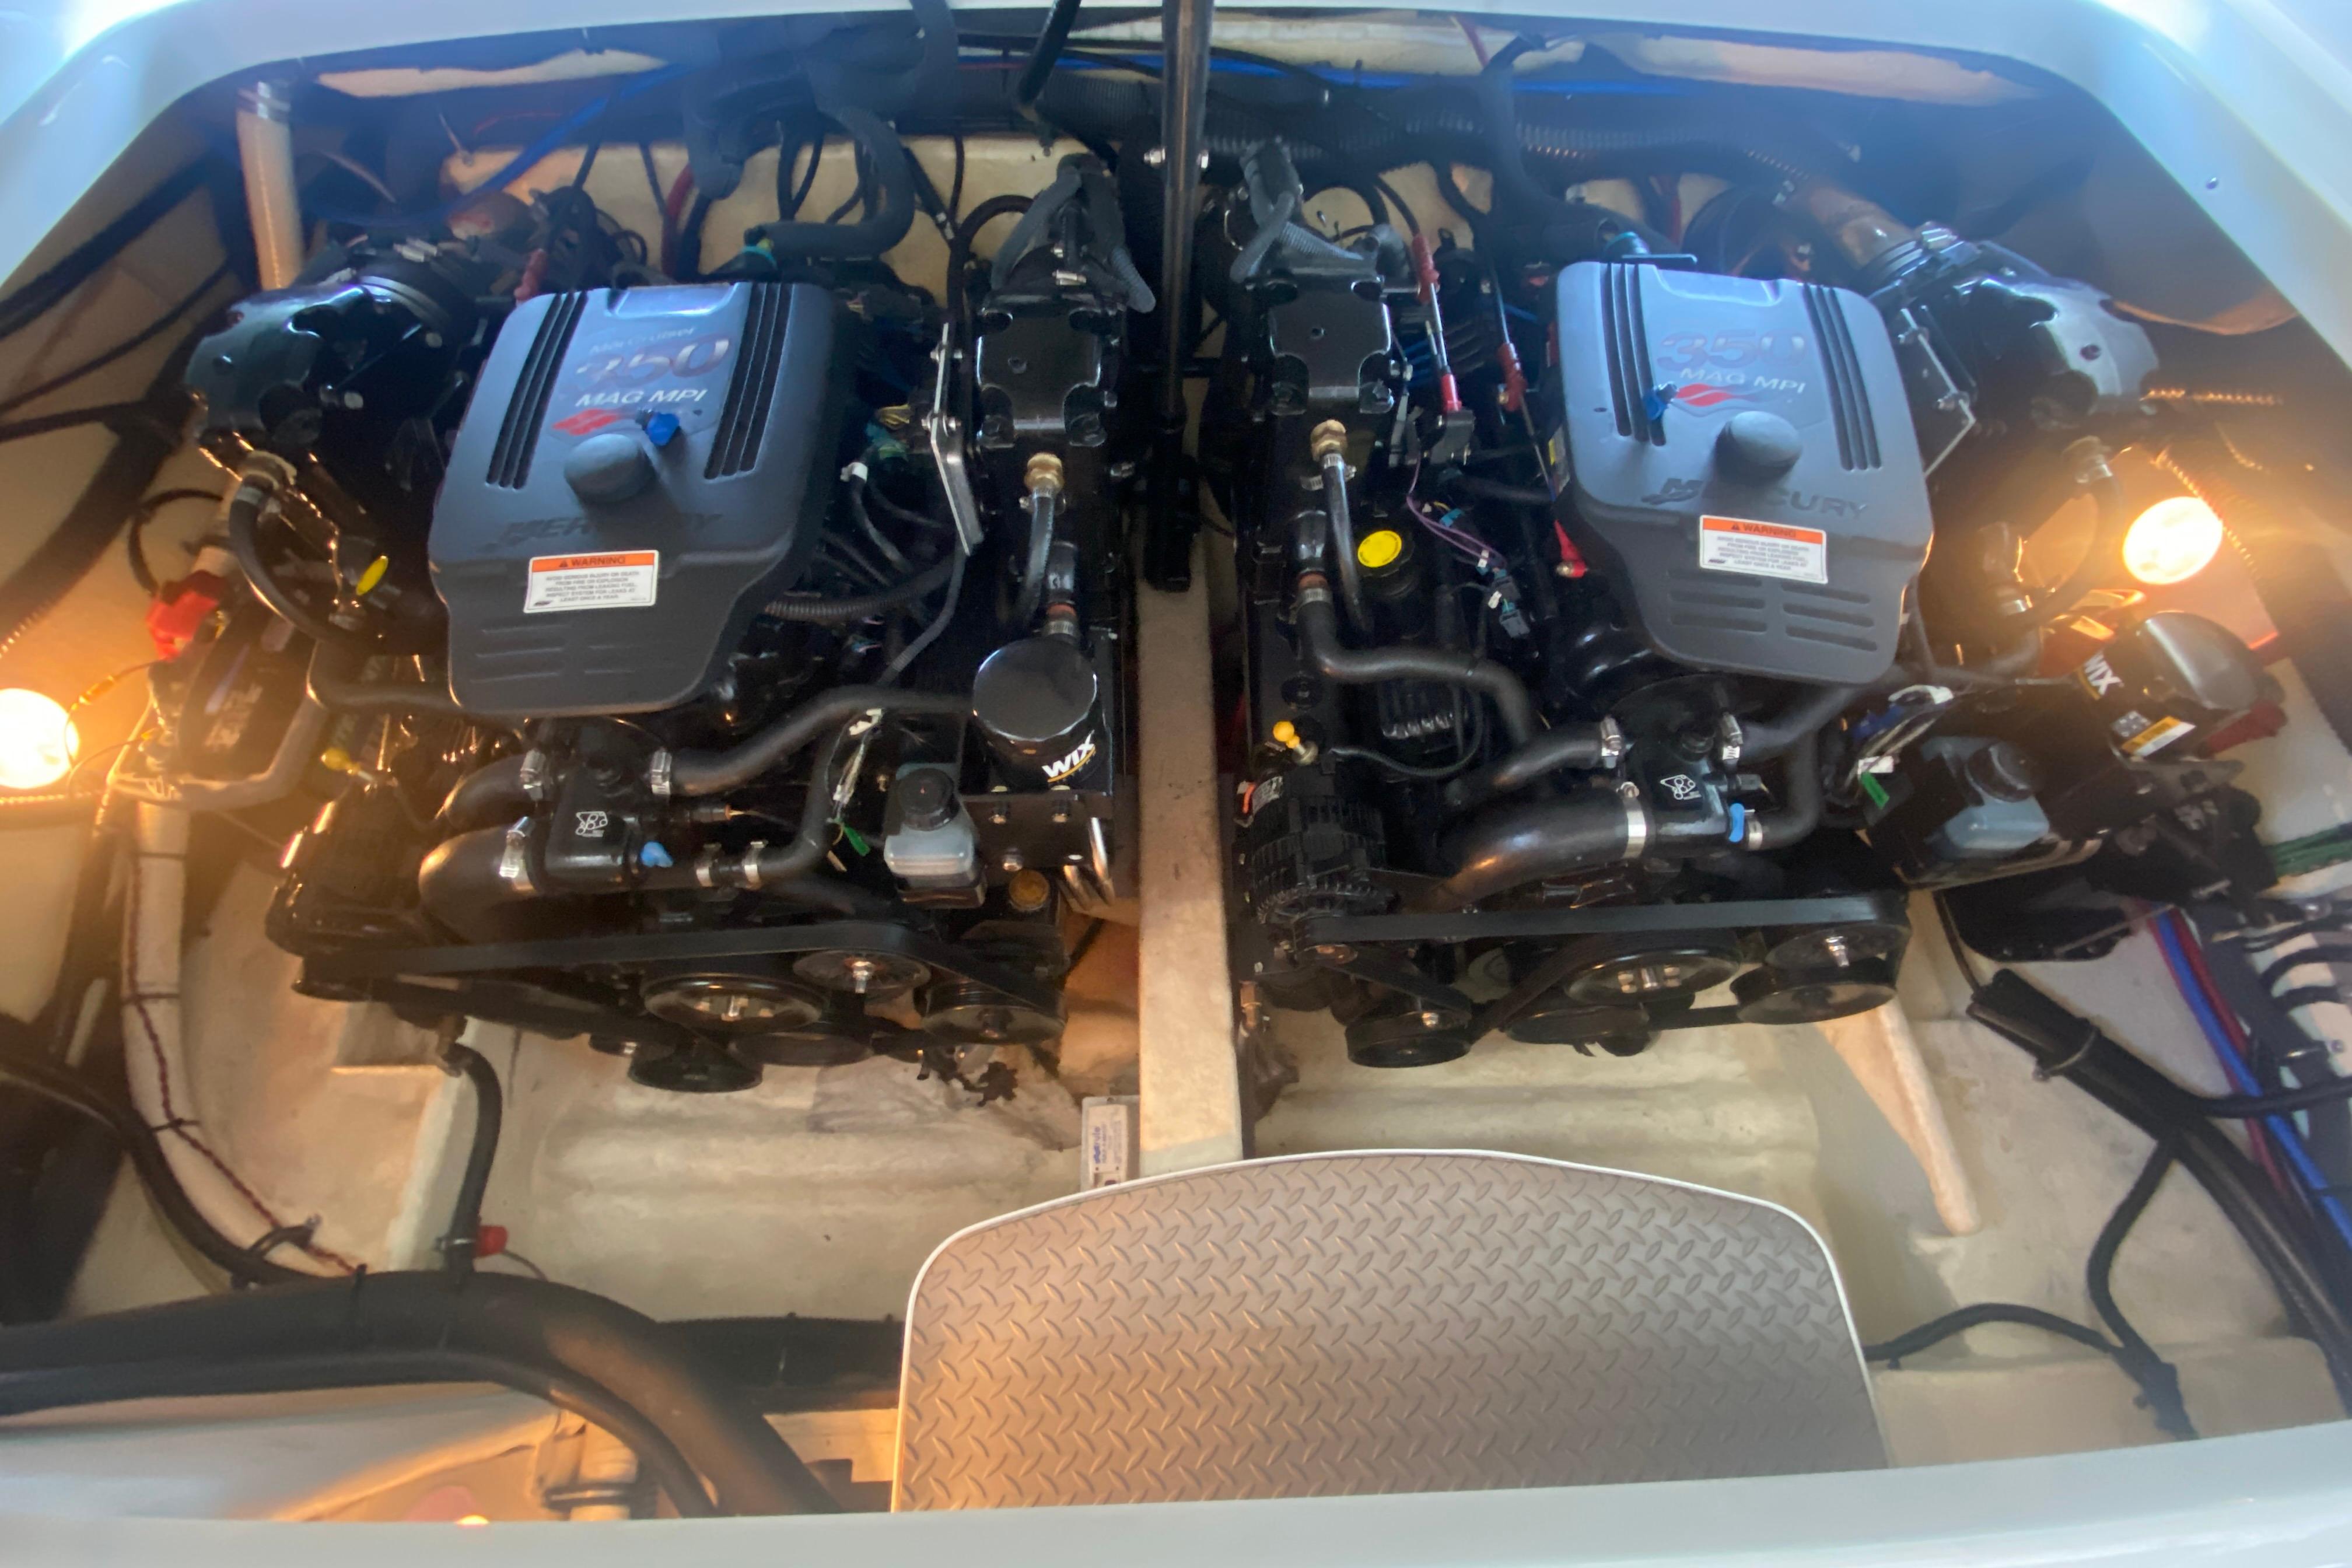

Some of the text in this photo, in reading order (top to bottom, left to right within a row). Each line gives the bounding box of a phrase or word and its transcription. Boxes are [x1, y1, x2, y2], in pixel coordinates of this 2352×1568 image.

[1657, 328, 1807, 372] 350
[1679, 367, 1807, 394] MAG MPI
[575, 388, 709, 407] MAG MPI
[1744, 522, 1796, 540] WARNING
[571, 556, 625, 566] WARNING
[2083, 649, 2124, 695] WIX
[1041, 729, 1095, 778] WIX
